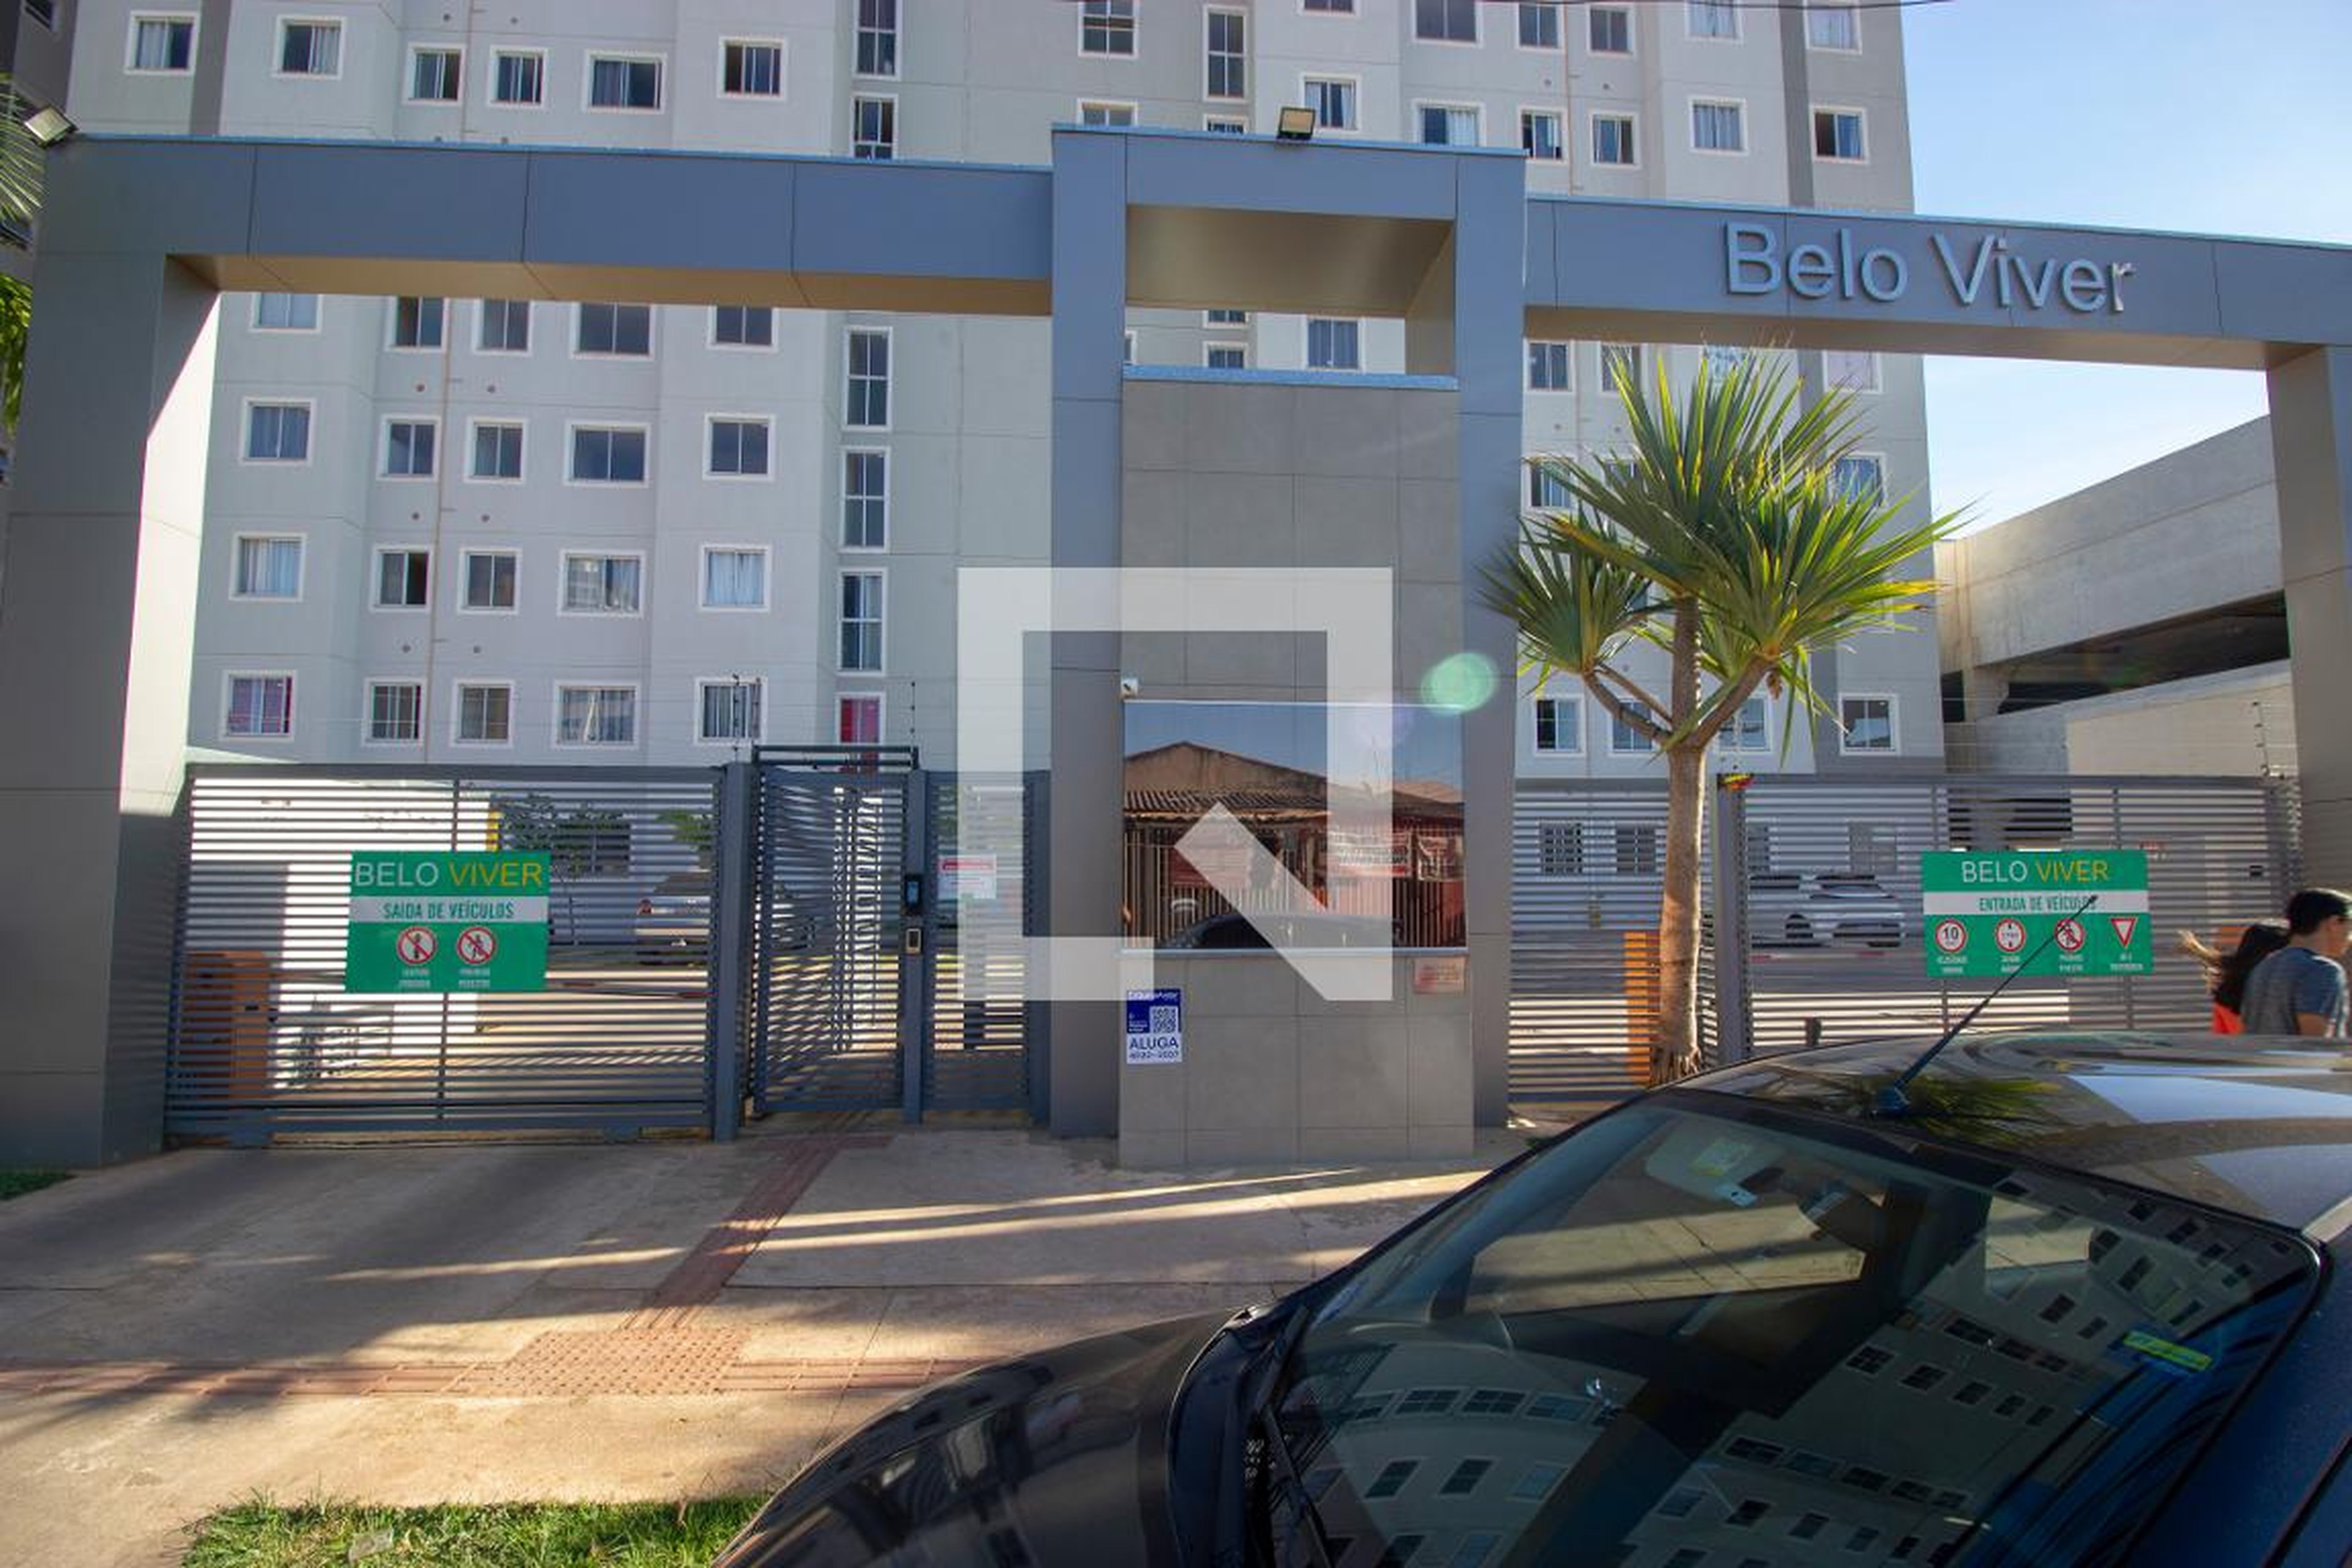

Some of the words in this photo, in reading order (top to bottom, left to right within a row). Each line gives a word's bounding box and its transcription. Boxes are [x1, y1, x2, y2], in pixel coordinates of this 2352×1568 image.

[1724, 221, 1908, 301] Belo
[1932, 233, 2135, 312] Viver
[355, 862, 439, 886] BELO
[448, 862, 543, 886] VIVER
[1961, 861, 2028, 883] BELO
[2036, 859, 2109, 883] VIVER
[428, 902, 443, 919] DE
[1979, 897, 2026, 911] ENTRADA
[2029, 896, 2042, 911] DE
[1943, 926, 1959, 940] 10
[1129, 1037, 1179, 1050] ALUGA
